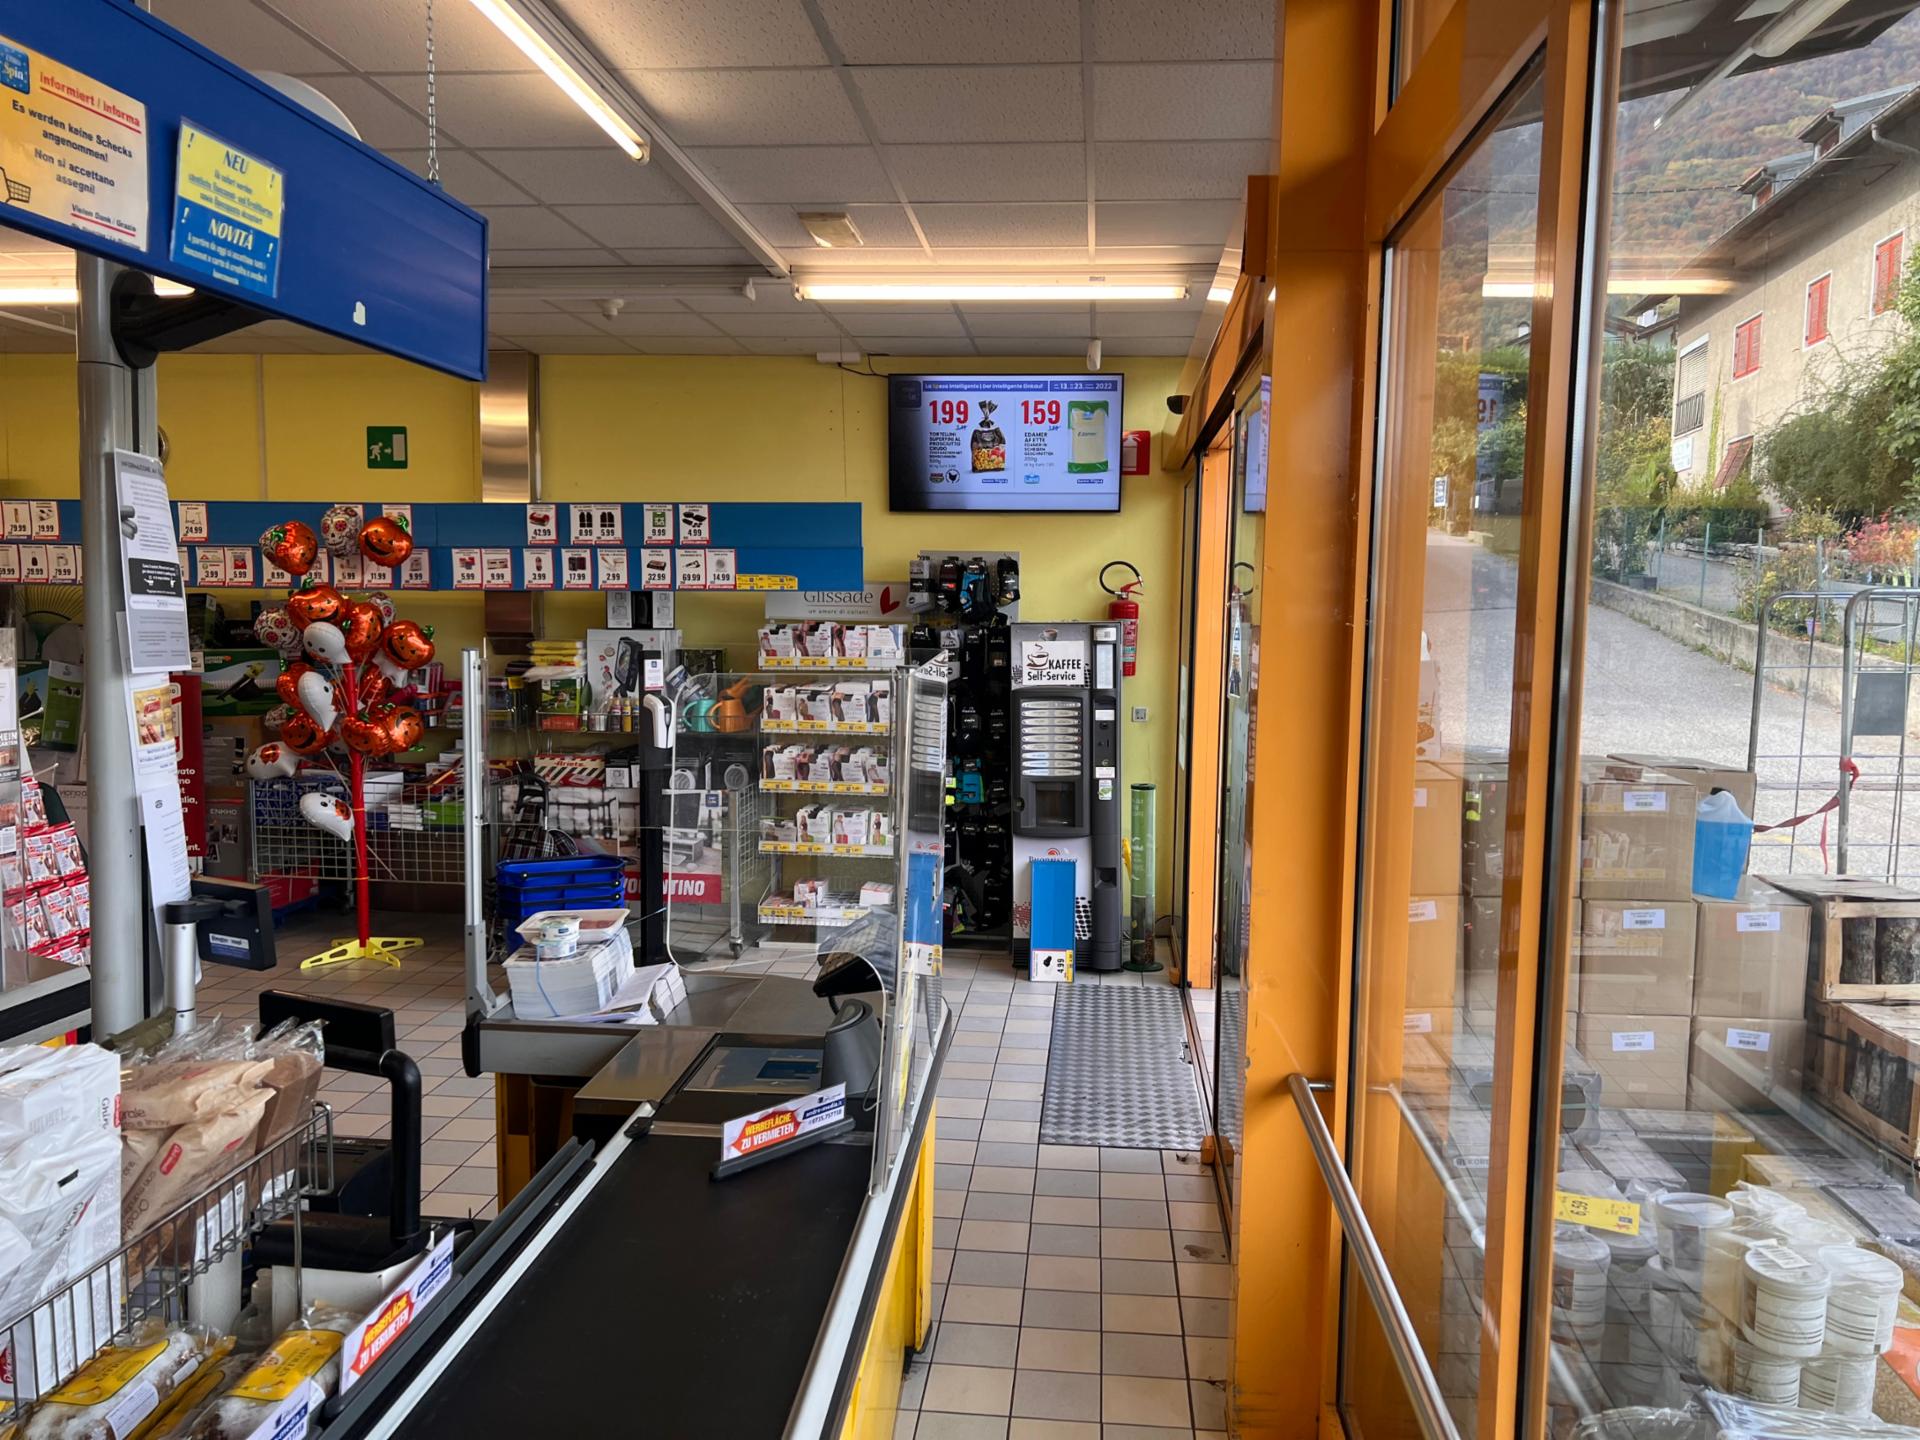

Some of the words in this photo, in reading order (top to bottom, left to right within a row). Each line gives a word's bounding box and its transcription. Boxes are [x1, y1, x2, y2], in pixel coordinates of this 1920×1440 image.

[12, 99, 25, 113] Es
[28, 108, 66, 130] werden
[68, 123, 93, 141] keine
[96, 134, 132, 158] Schecks
[43, 130, 108, 162] angenommen!
[35, 148, 54, 164] Non
[58, 158, 66, 168] si
[69, 162, 115, 187] accettano
[224, 150, 249, 174] NEU
[208, 218, 254, 251] NOVITÀ
[929, 400, 969, 426] 1,99
[1021, 400, 1061, 426] 1,59
[233, 571, 247, 579] 5.99
[371, 572, 386, 580] 11.99
[804, 590, 873, 604] Glissade
[1027, 671, 1076, 681] Self-Service
[1048, 659, 1082, 670] KAFFEE
[745, 1112, 792, 1136] WERBEFLÄCHE
[741, 1138, 752, 1150] ZU
[753, 1123, 794, 1146] VERMIETEN
[360, 1348, 370, 1370] ZU
